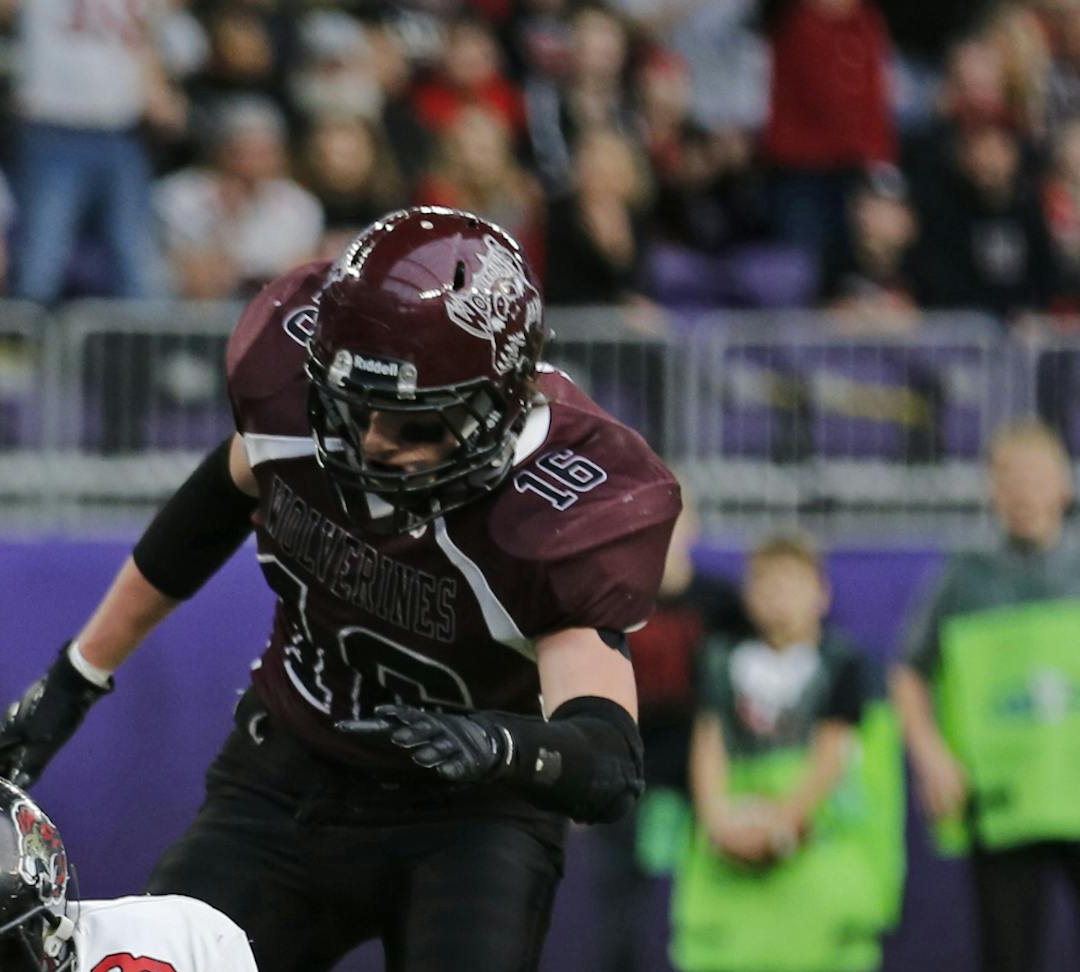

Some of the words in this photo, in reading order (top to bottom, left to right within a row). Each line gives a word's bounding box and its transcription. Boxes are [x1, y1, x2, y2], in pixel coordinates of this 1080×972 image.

[354, 353, 398, 377] Riddell
[514, 449, 607, 511] 16
[265, 474, 457, 643] WOLVERINES
